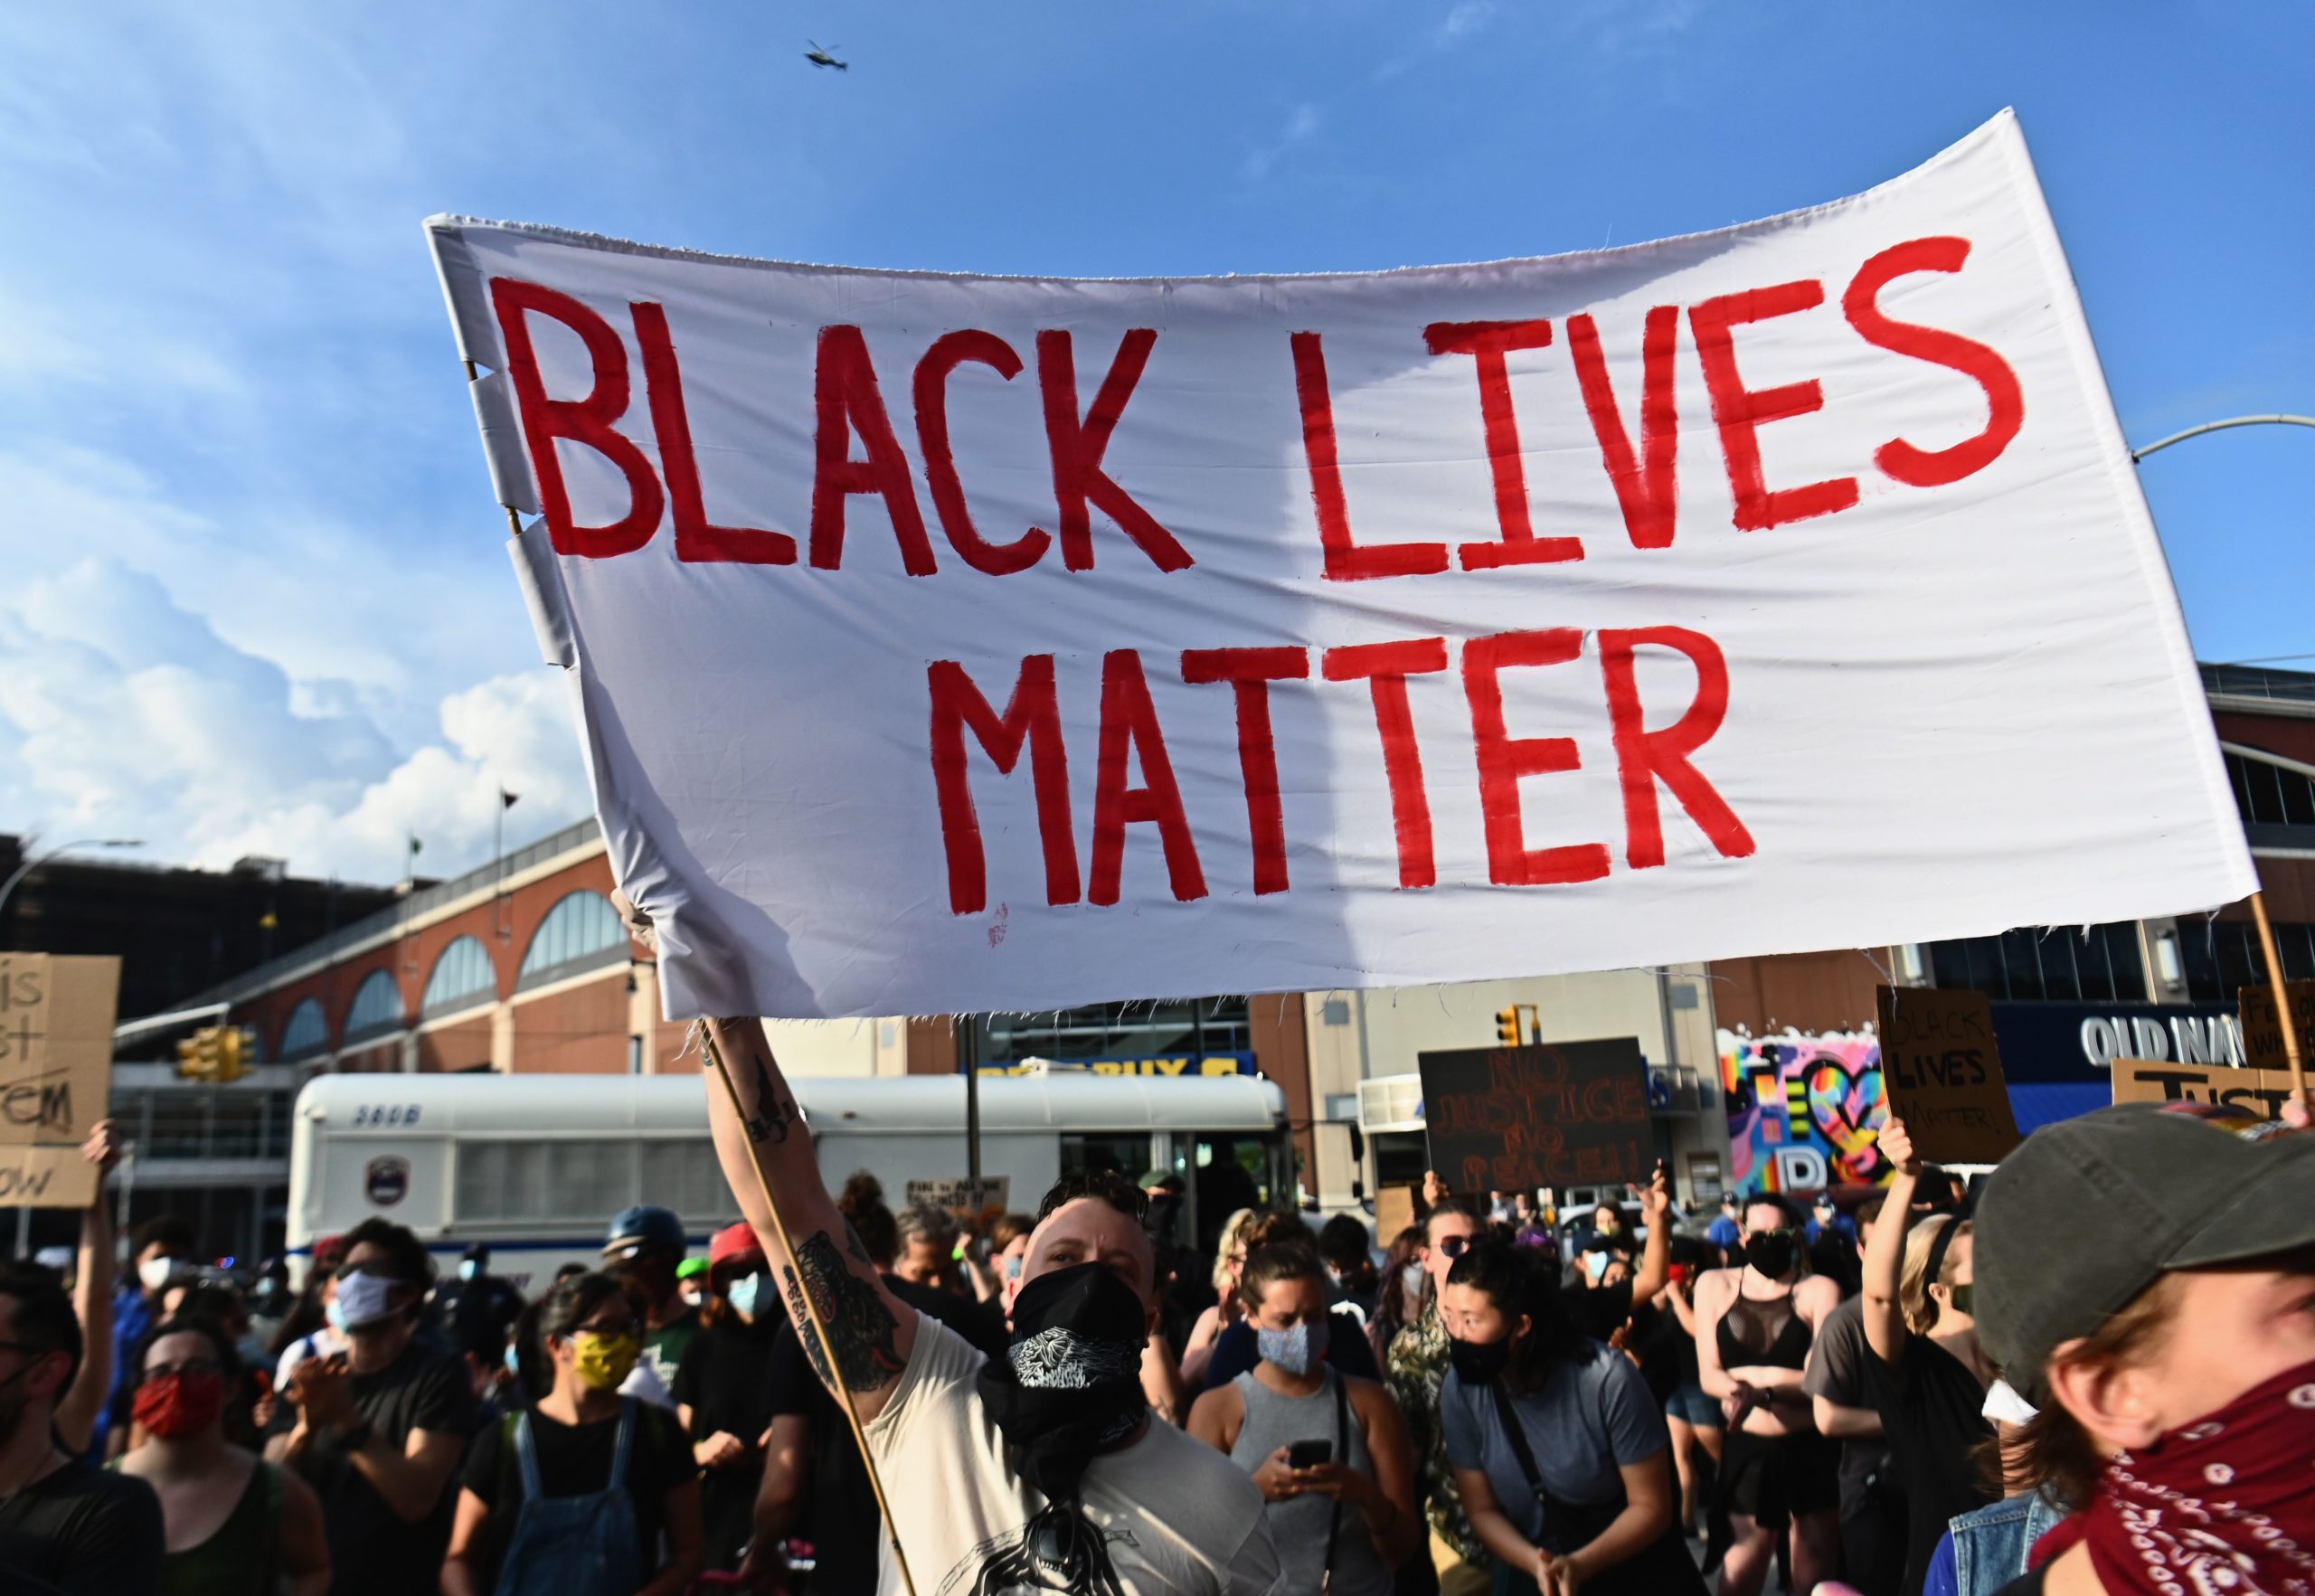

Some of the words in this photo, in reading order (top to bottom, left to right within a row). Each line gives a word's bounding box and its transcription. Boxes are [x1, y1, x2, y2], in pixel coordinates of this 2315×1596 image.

[493, 279, 1191, 574] BLACK
[1294, 236, 2025, 581] LIVES
[931, 626, 1756, 912] MATTER
[1885, 995, 1986, 1046] BLACK
[2081, 1015, 2169, 1067] OLD
[1488, 1046, 1568, 1093] NO
[1892, 1048, 1987, 1089] LIVES
[1432, 1077, 1648, 1136] JUSTICE
[1504, 1120, 1564, 1156] NO
